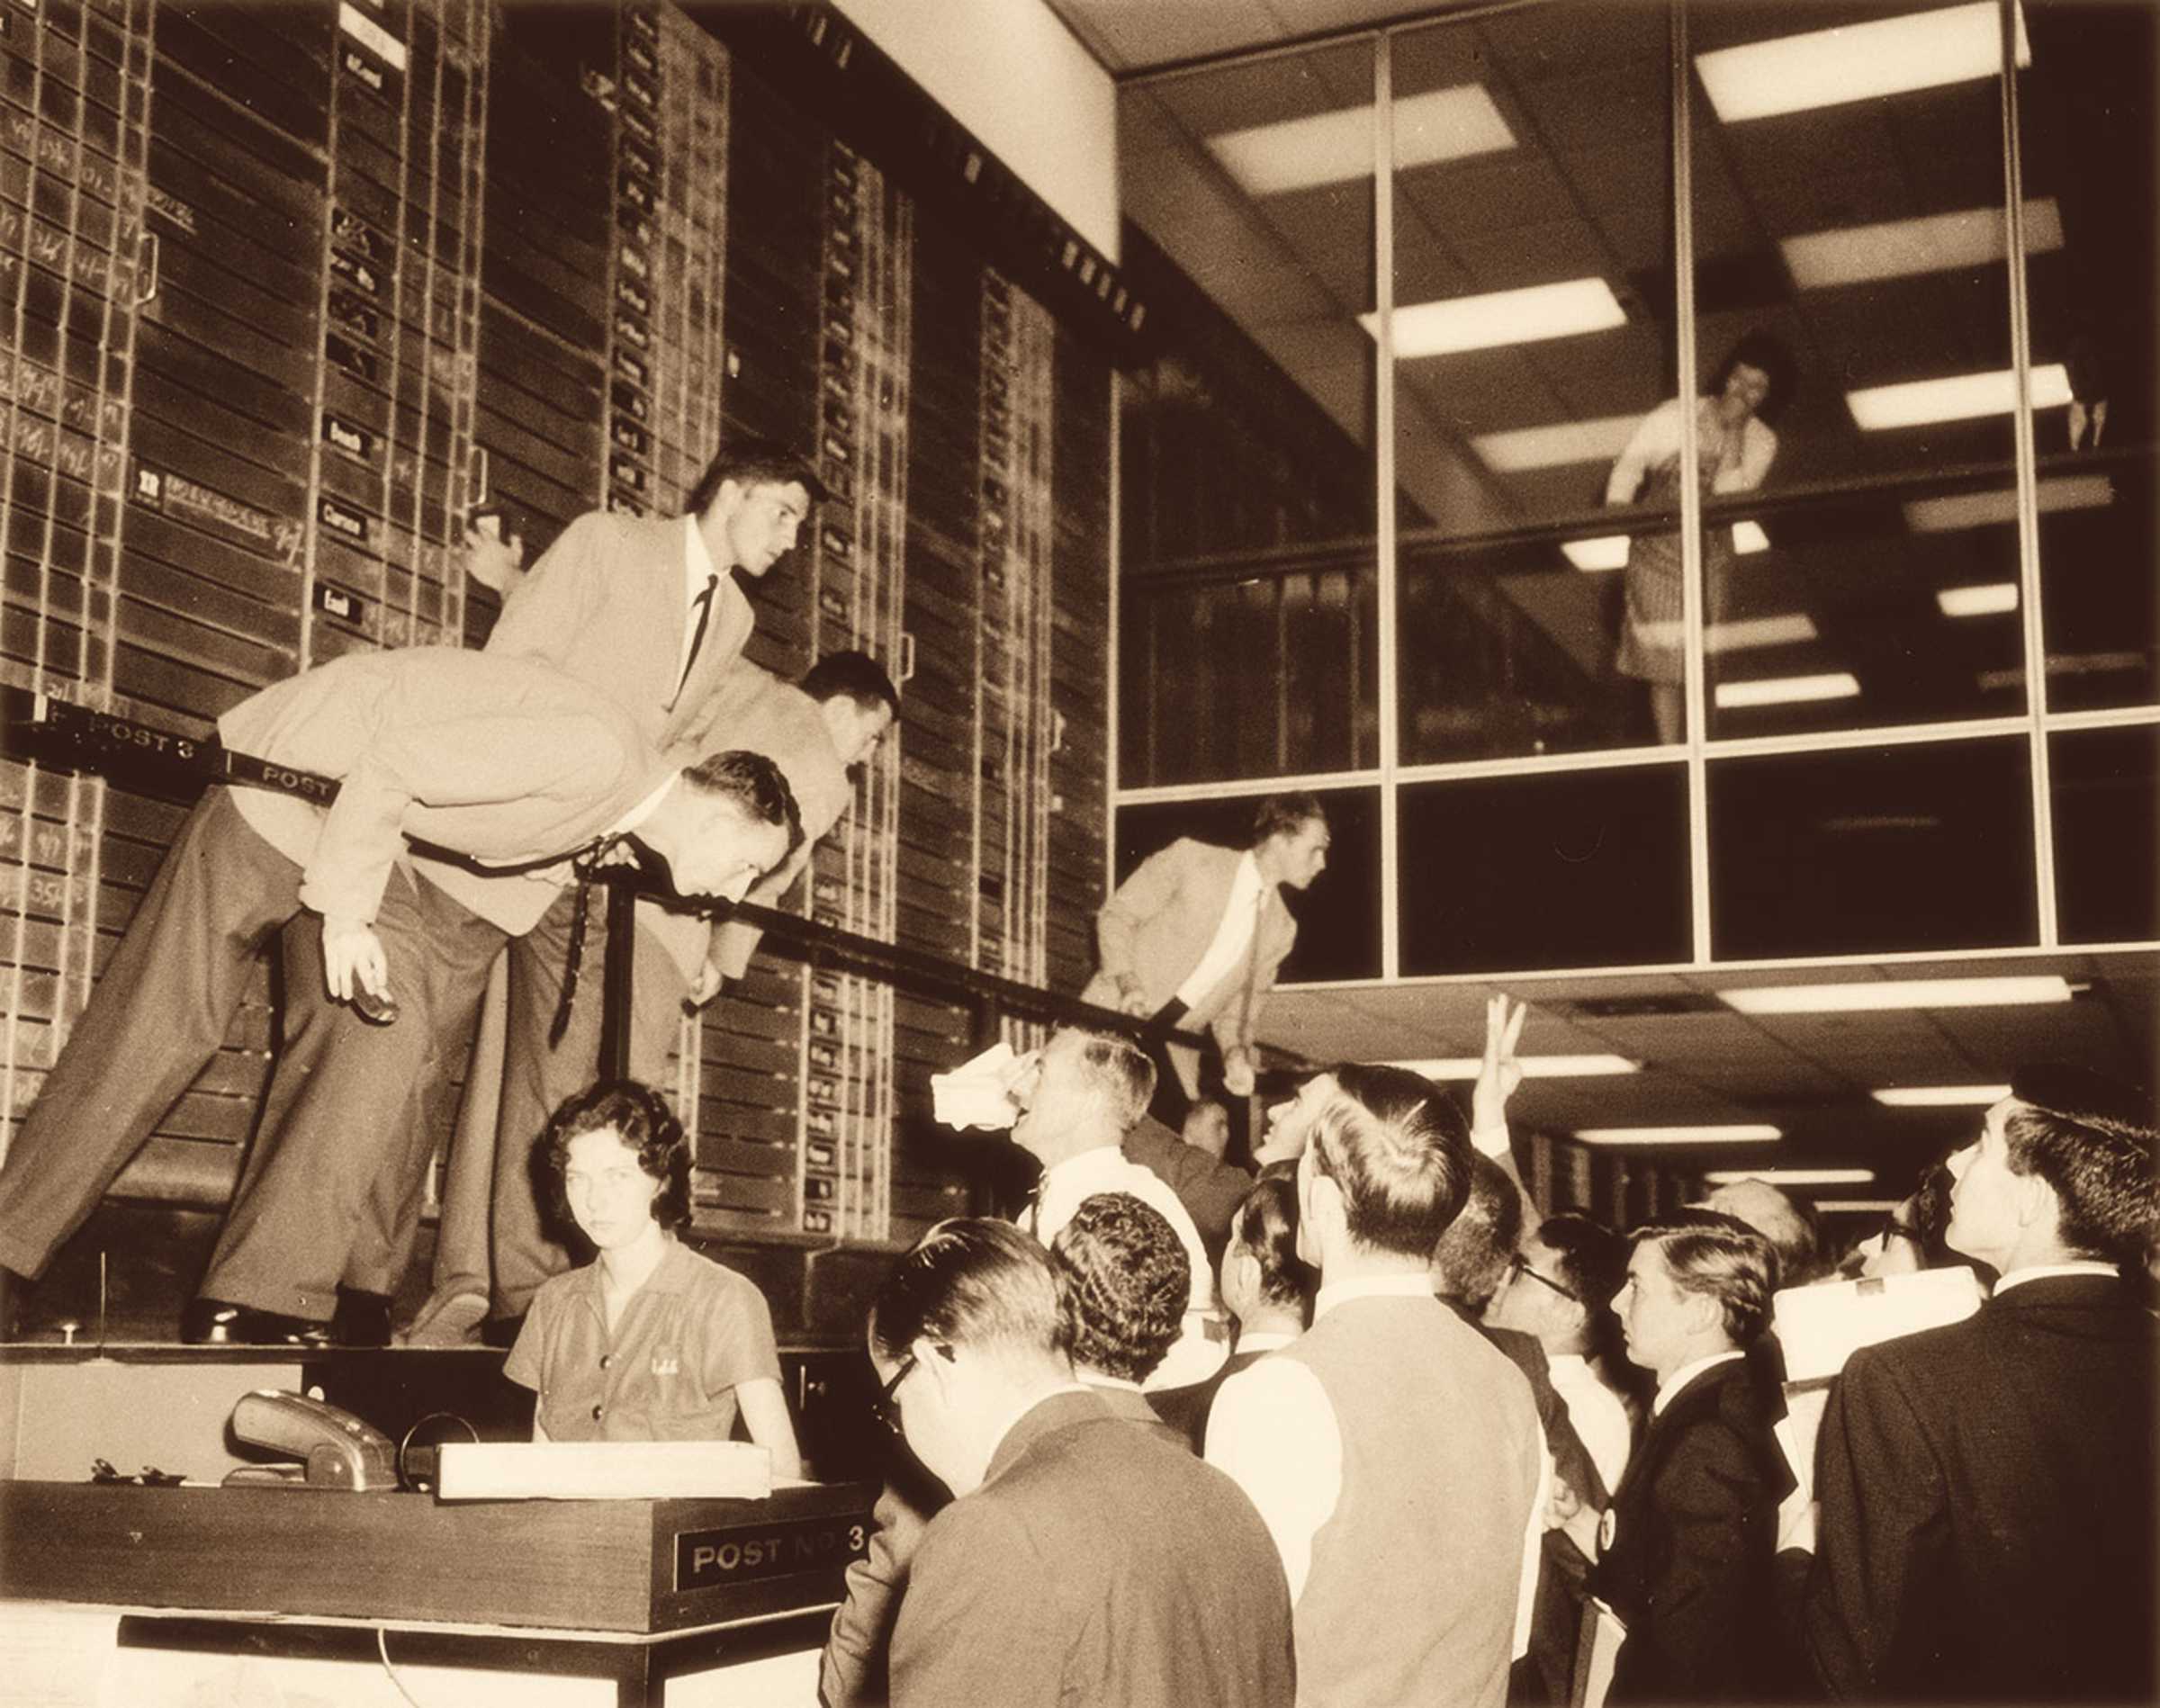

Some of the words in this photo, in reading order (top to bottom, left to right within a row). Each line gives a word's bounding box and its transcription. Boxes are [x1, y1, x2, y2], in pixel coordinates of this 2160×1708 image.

[88, 715, 169, 752] POST
[176, 740, 195, 760] 3
[262, 765, 331, 797] POST
[693, 1537, 782, 1574] POST
[848, 1524, 865, 1551] 3
